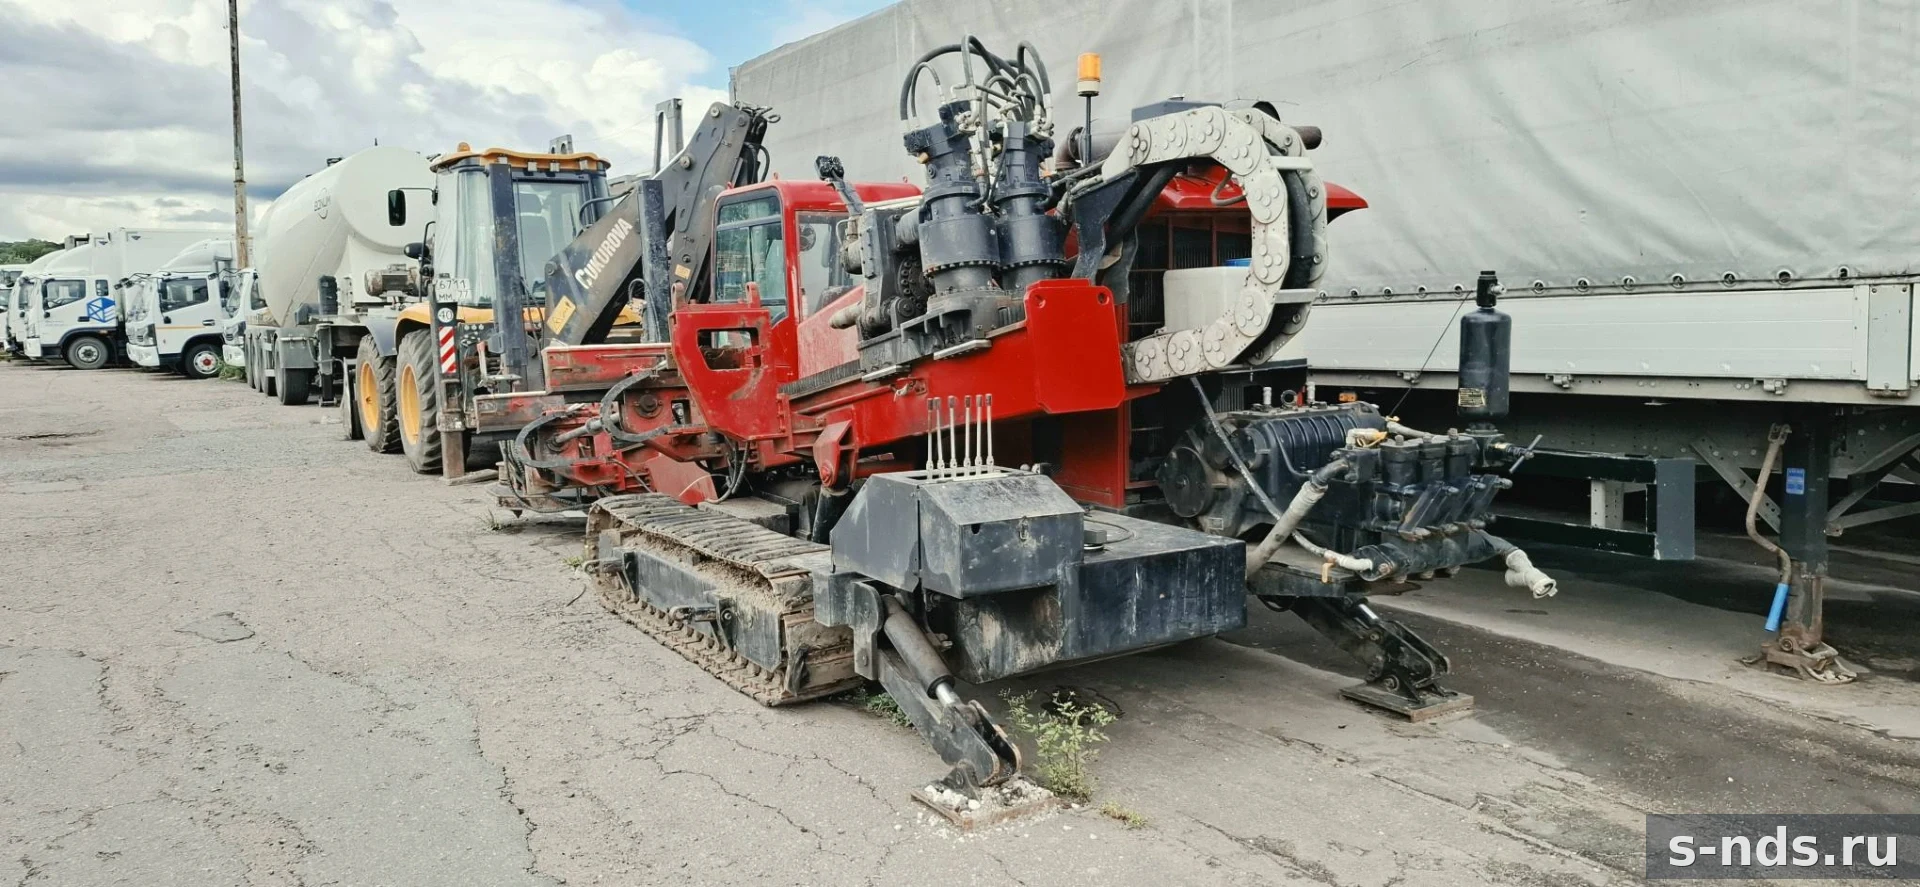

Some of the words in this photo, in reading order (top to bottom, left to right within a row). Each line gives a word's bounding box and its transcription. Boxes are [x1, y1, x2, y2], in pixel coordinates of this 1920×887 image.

[574, 217, 633, 289] CUKUROVA
[439, 279, 466, 289] 6711
[438, 310, 454, 320] 40
